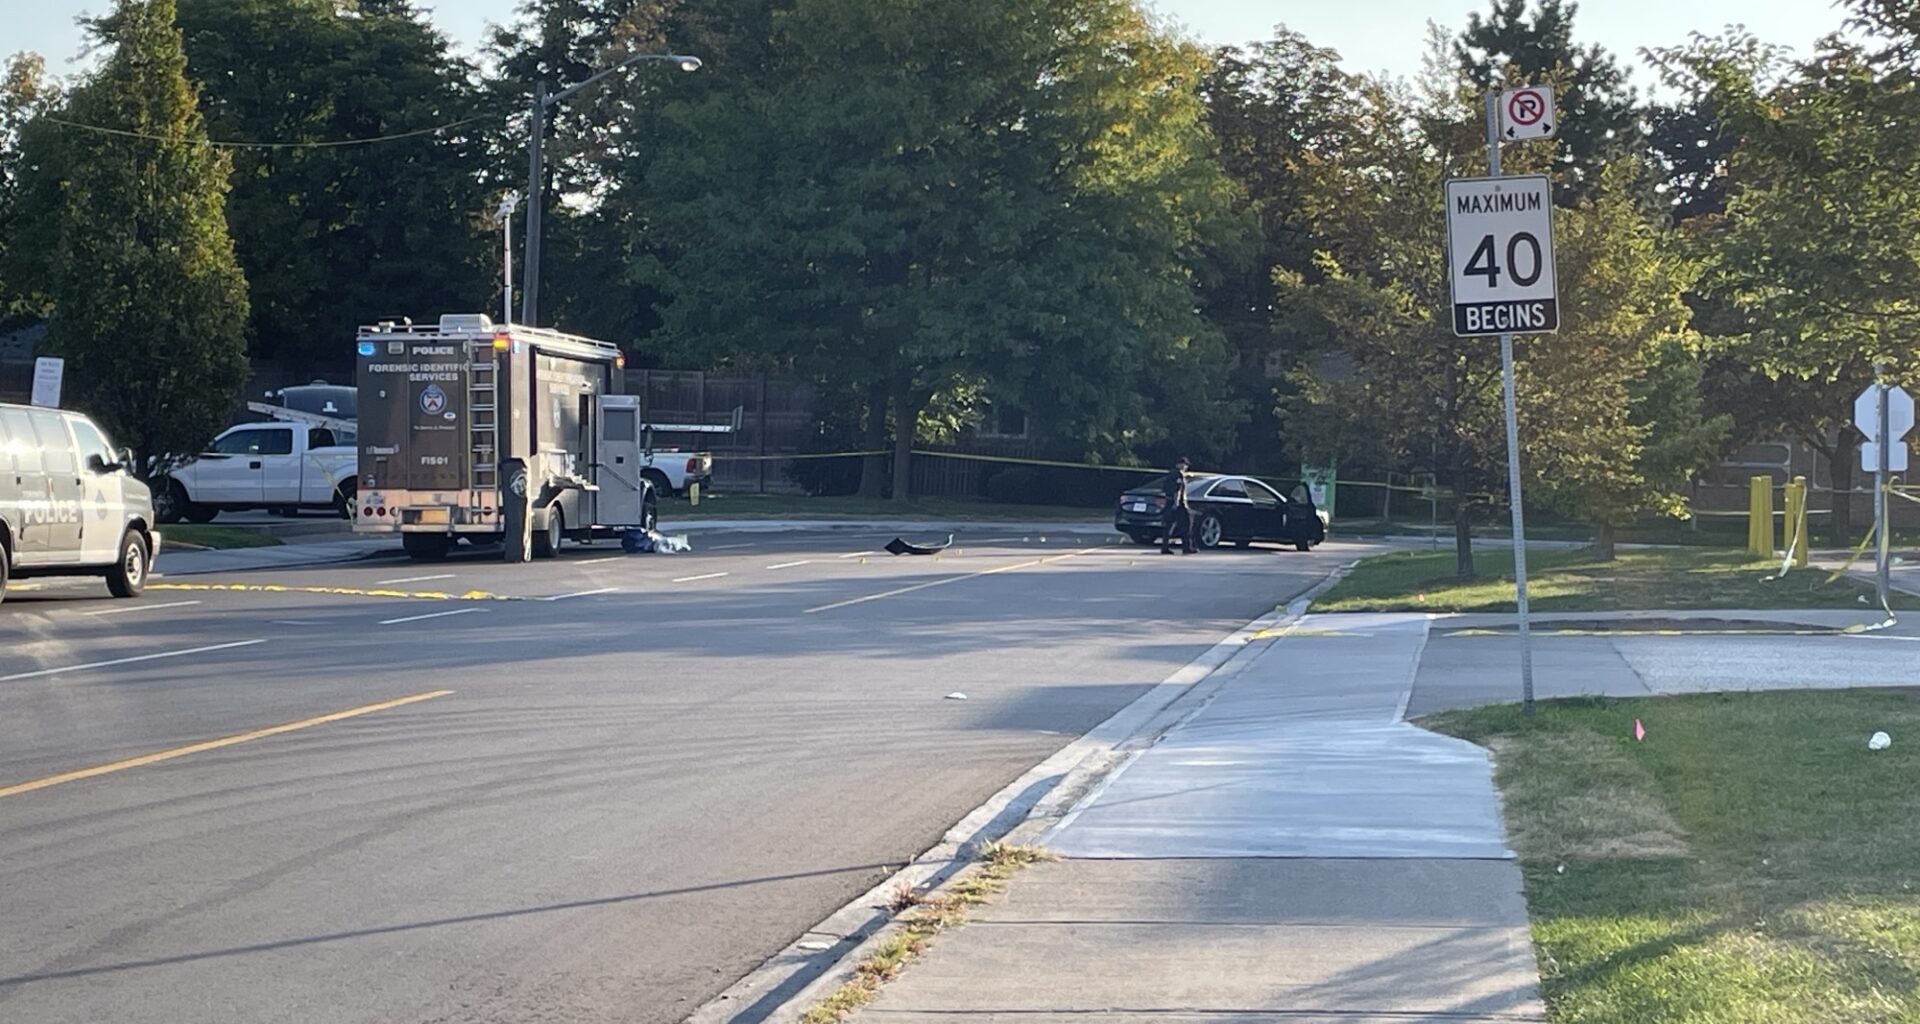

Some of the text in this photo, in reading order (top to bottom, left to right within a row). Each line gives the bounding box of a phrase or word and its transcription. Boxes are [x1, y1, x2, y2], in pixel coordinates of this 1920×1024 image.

[1457, 191, 1541, 215] MAXIMUM
[1463, 231, 1542, 288] 40
[1466, 303, 1546, 331] BEGINS
[412, 346, 454, 355] POLICE
[368, 363, 470, 372] FORENSIC IDENTIFIC
[409, 372, 459, 381] SERVICES
[421, 456, 449, 465] FIS01
[24, 500, 78, 524] POLICE
